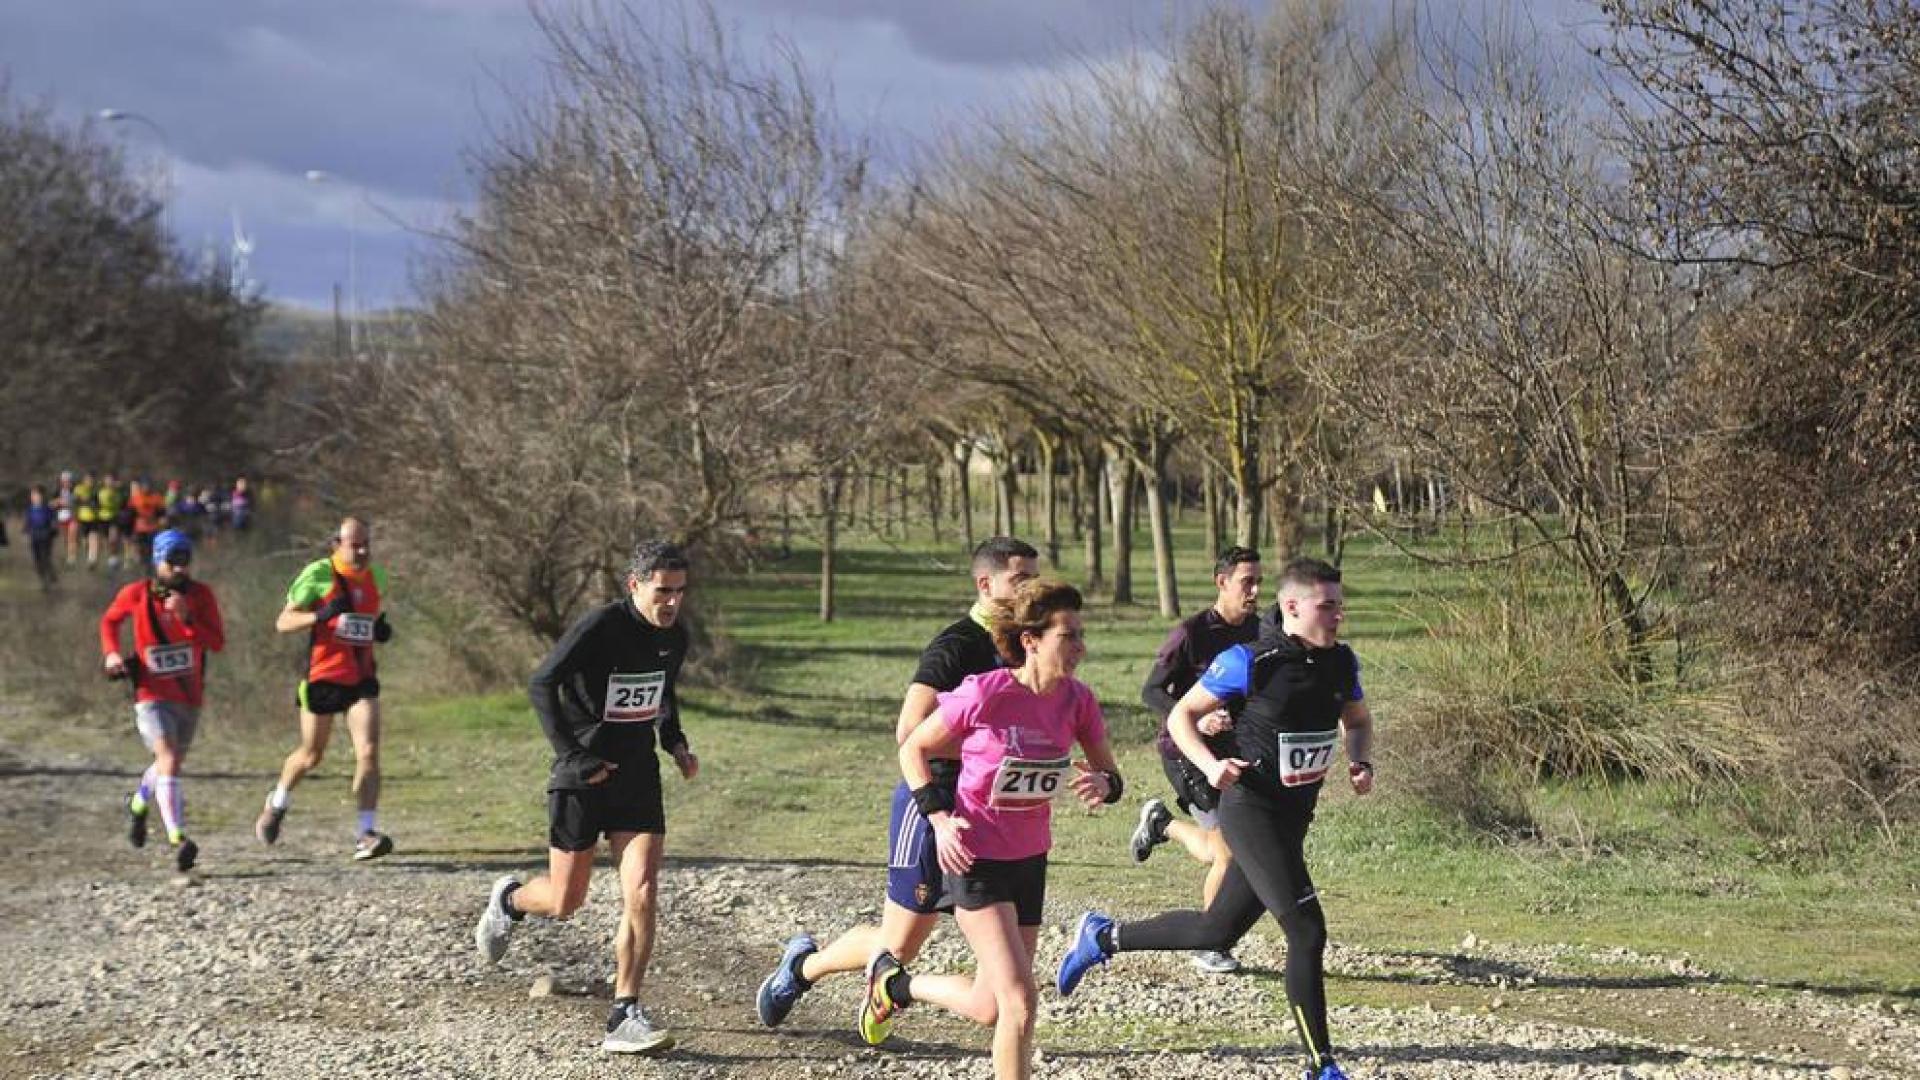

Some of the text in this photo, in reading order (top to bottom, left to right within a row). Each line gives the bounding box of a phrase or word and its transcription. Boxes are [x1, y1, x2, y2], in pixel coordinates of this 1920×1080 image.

[614, 686, 658, 708] 257
[1290, 744, 1333, 770] 077
[1001, 771, 1061, 793] 216
